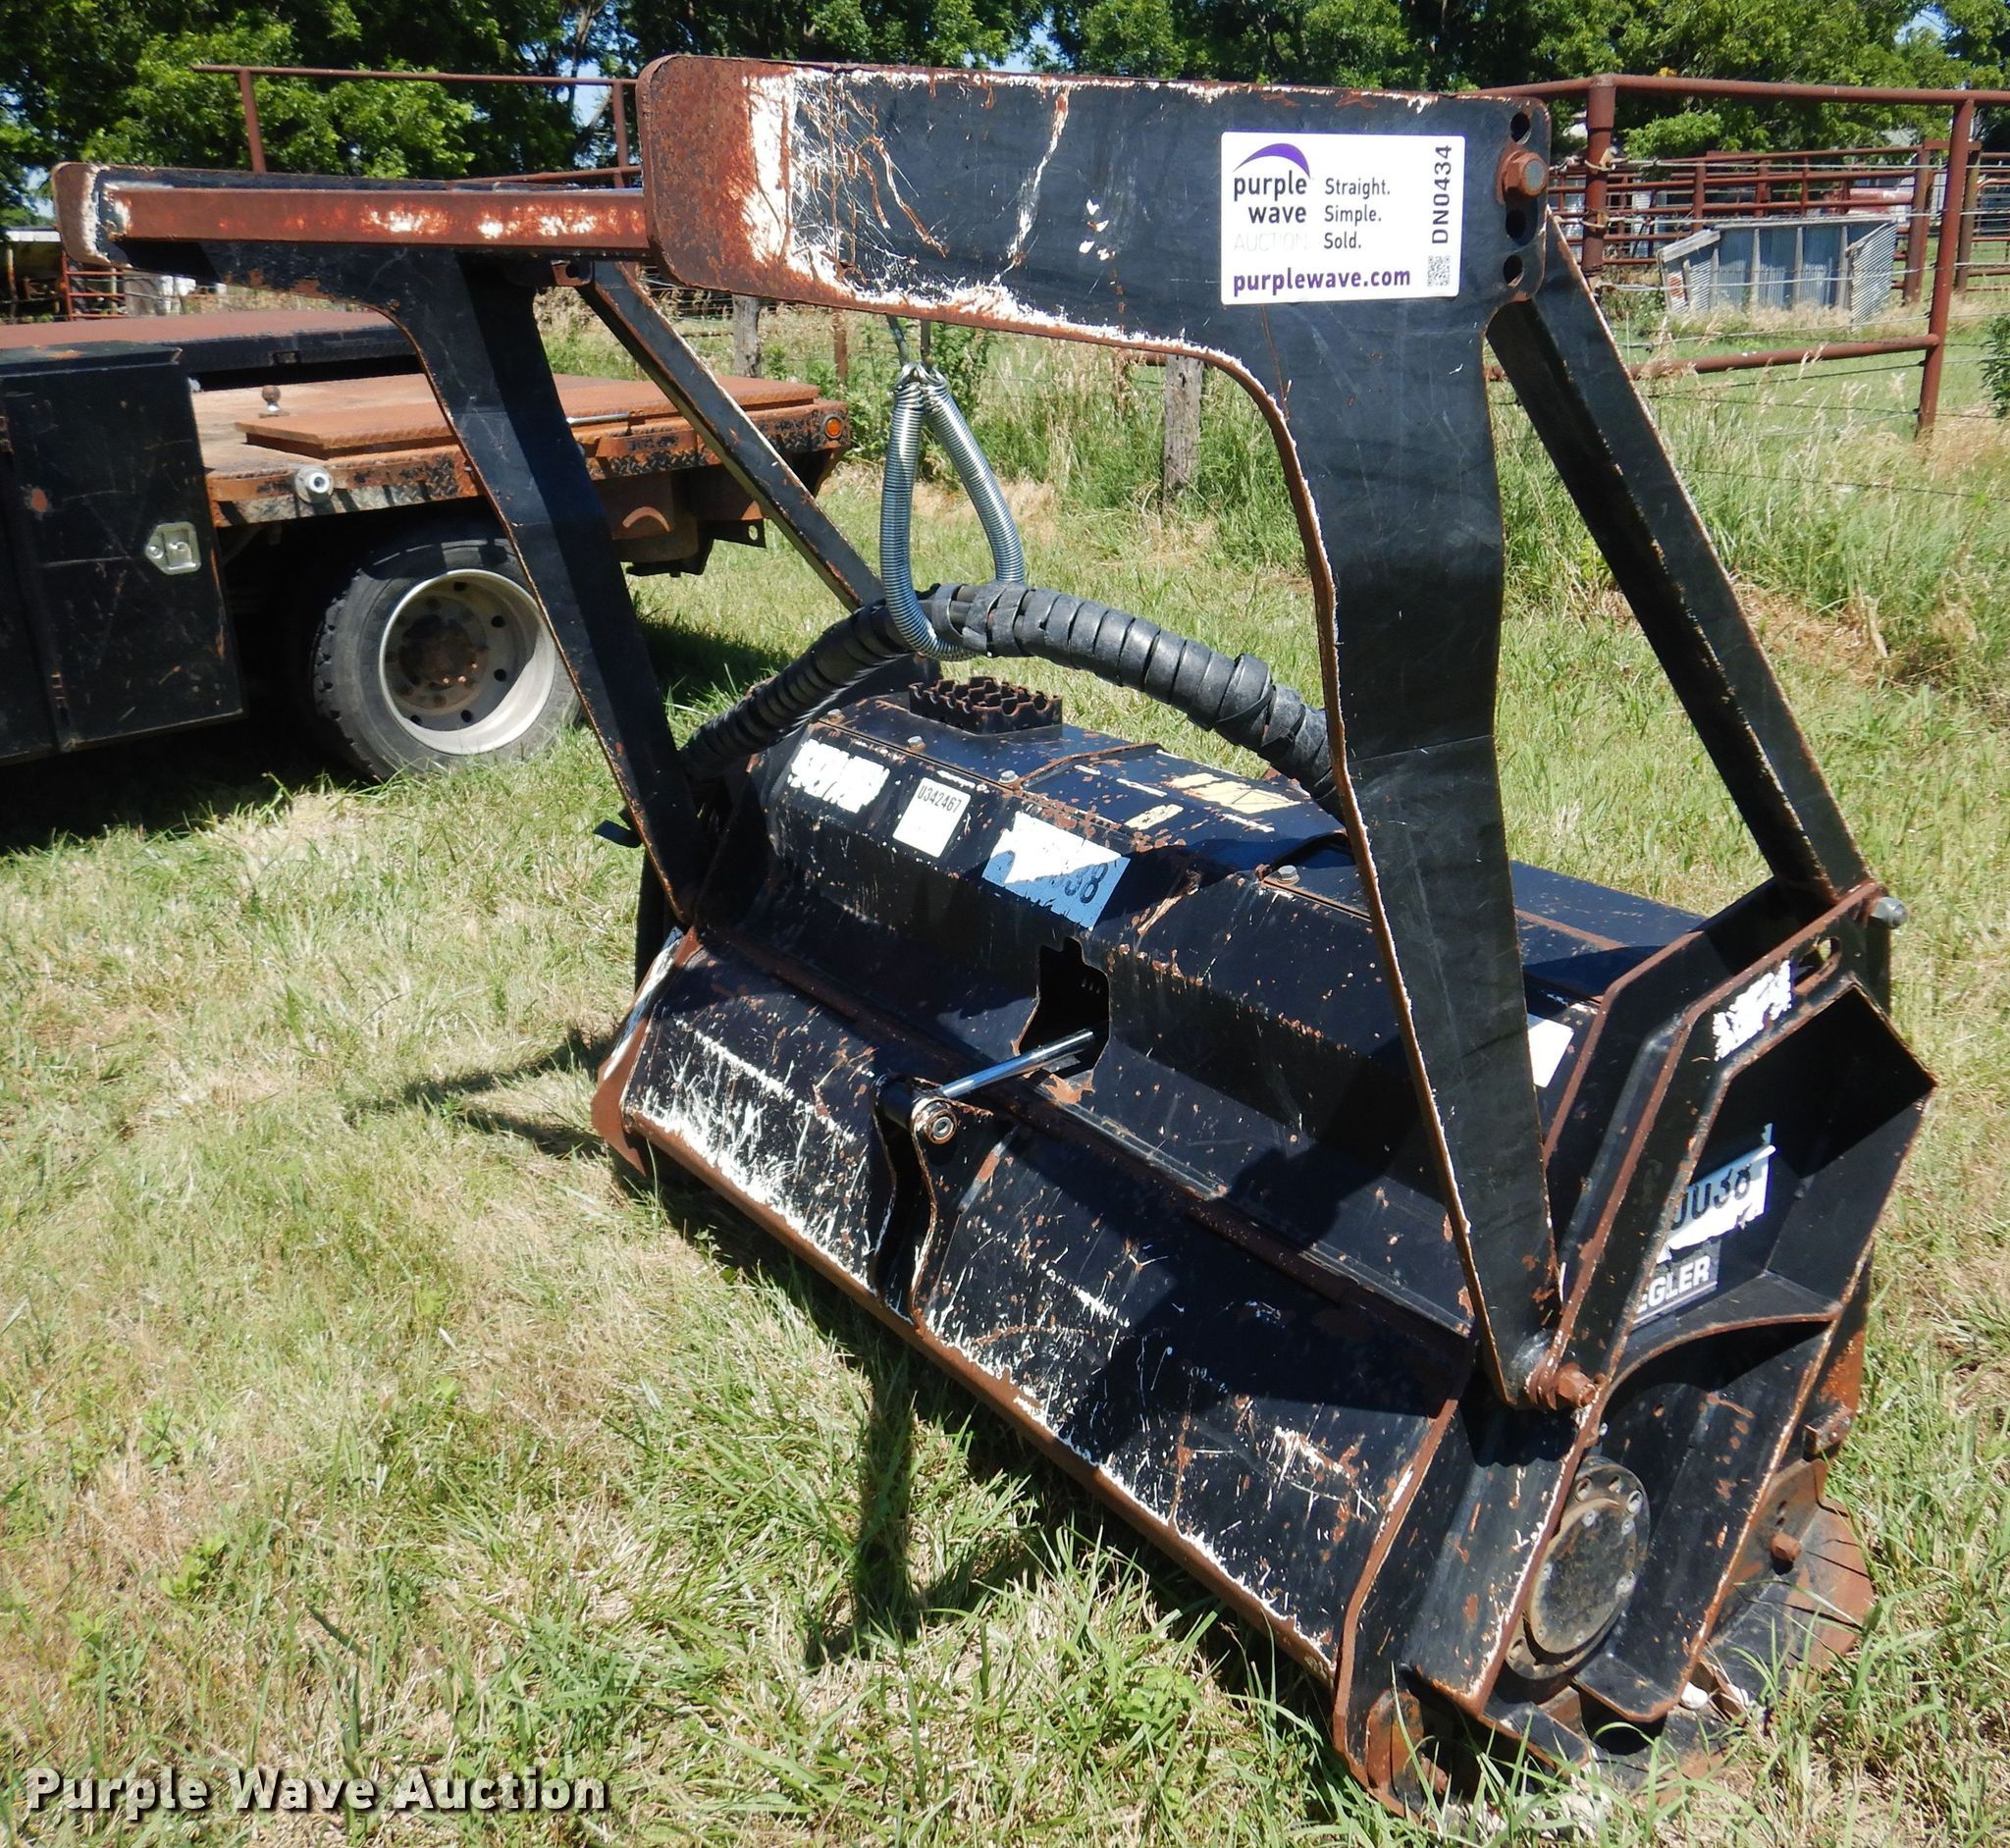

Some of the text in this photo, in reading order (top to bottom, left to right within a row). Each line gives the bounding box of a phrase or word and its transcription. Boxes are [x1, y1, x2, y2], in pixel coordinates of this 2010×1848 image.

[1234, 170, 1307, 201] purple
[1325, 177, 1391, 199] Straight.
[1432, 144, 1452, 244] DN0434
[1248, 205, 1306, 224] wave
[1325, 204, 1382, 226] Simple.
[1324, 232, 1362, 249] Sold.
[1234, 267, 1411, 297] purplewave.com
